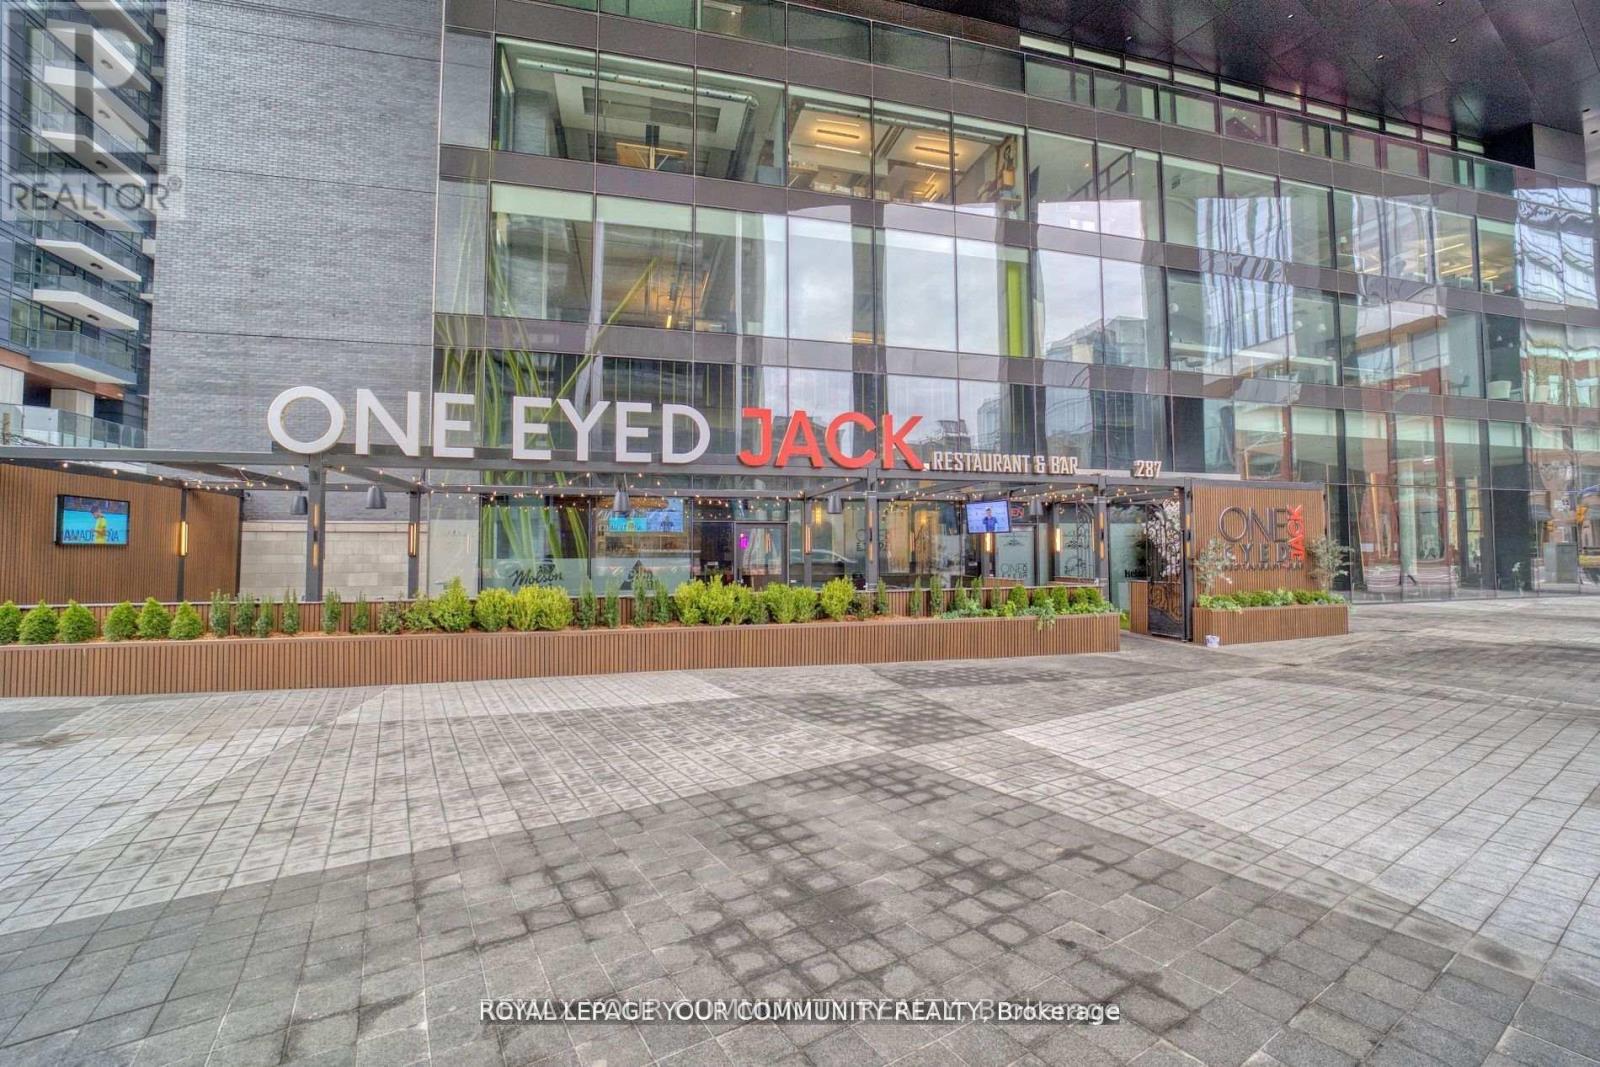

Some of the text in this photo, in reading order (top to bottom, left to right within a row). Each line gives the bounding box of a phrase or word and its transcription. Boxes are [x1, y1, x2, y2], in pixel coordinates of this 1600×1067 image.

[267, 386, 924, 471] ONE EYED JACK
[932, 451, 1079, 475] RESTAURANT & BAR
[1133, 460, 1162, 478] 287
[1218, 506, 1288, 543] ONE
[1287, 504, 1305, 560] JACK
[1223, 543, 1291, 563] EYED
[508, 568, 564, 587] Molson
